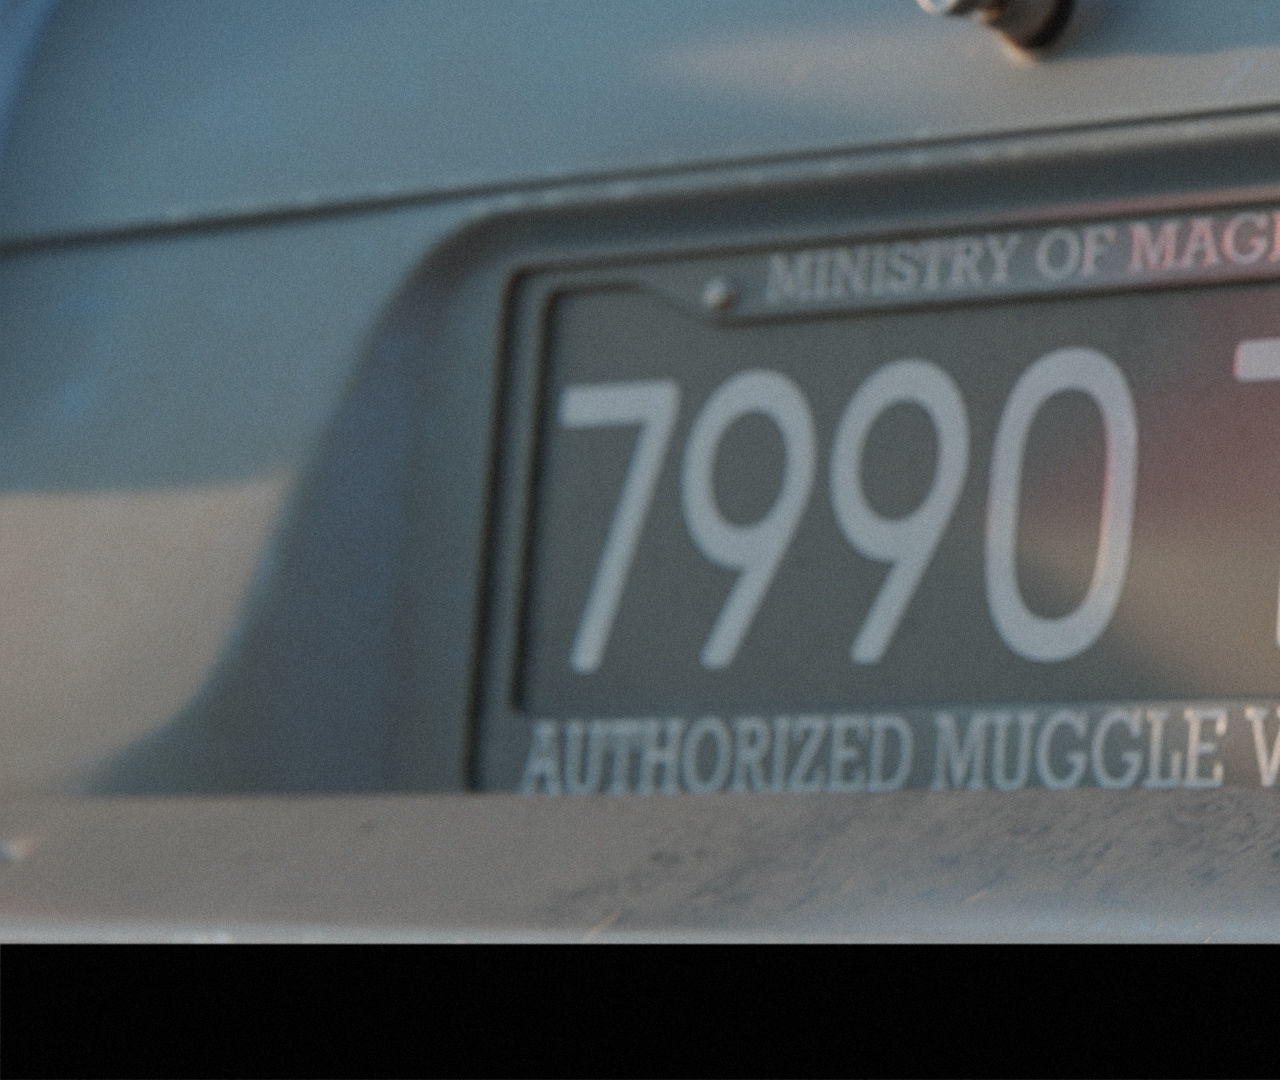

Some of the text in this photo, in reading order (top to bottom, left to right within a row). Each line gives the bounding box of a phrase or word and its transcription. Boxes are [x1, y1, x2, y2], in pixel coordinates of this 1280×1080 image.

[767, 234, 1019, 303] MINISTRY
[1032, 225, 1114, 282] OF
[558, 346, 1140, 675] 7990
[523, 713, 912, 796] AUTHORIZED
[932, 705, 1225, 791] MUGGLE
